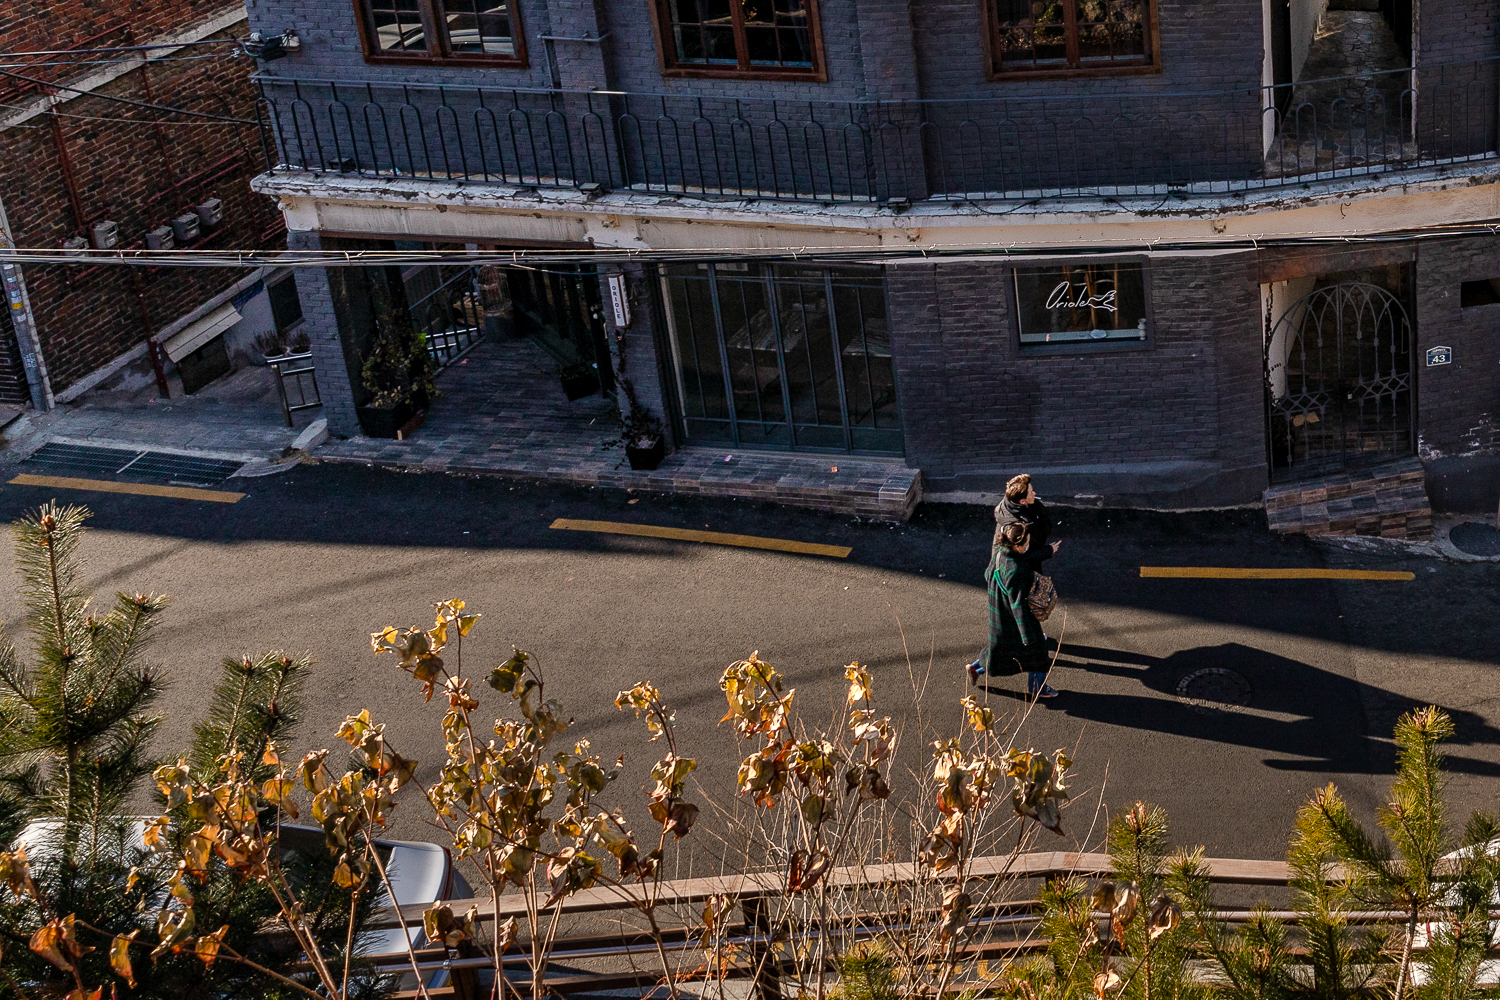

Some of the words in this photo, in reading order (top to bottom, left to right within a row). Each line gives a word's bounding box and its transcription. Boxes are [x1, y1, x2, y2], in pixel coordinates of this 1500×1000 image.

[611, 285, 622, 319] ORIOLE
[1045, 281, 1088, 309] Oriole
[1432, 354, 1446, 363] 43
